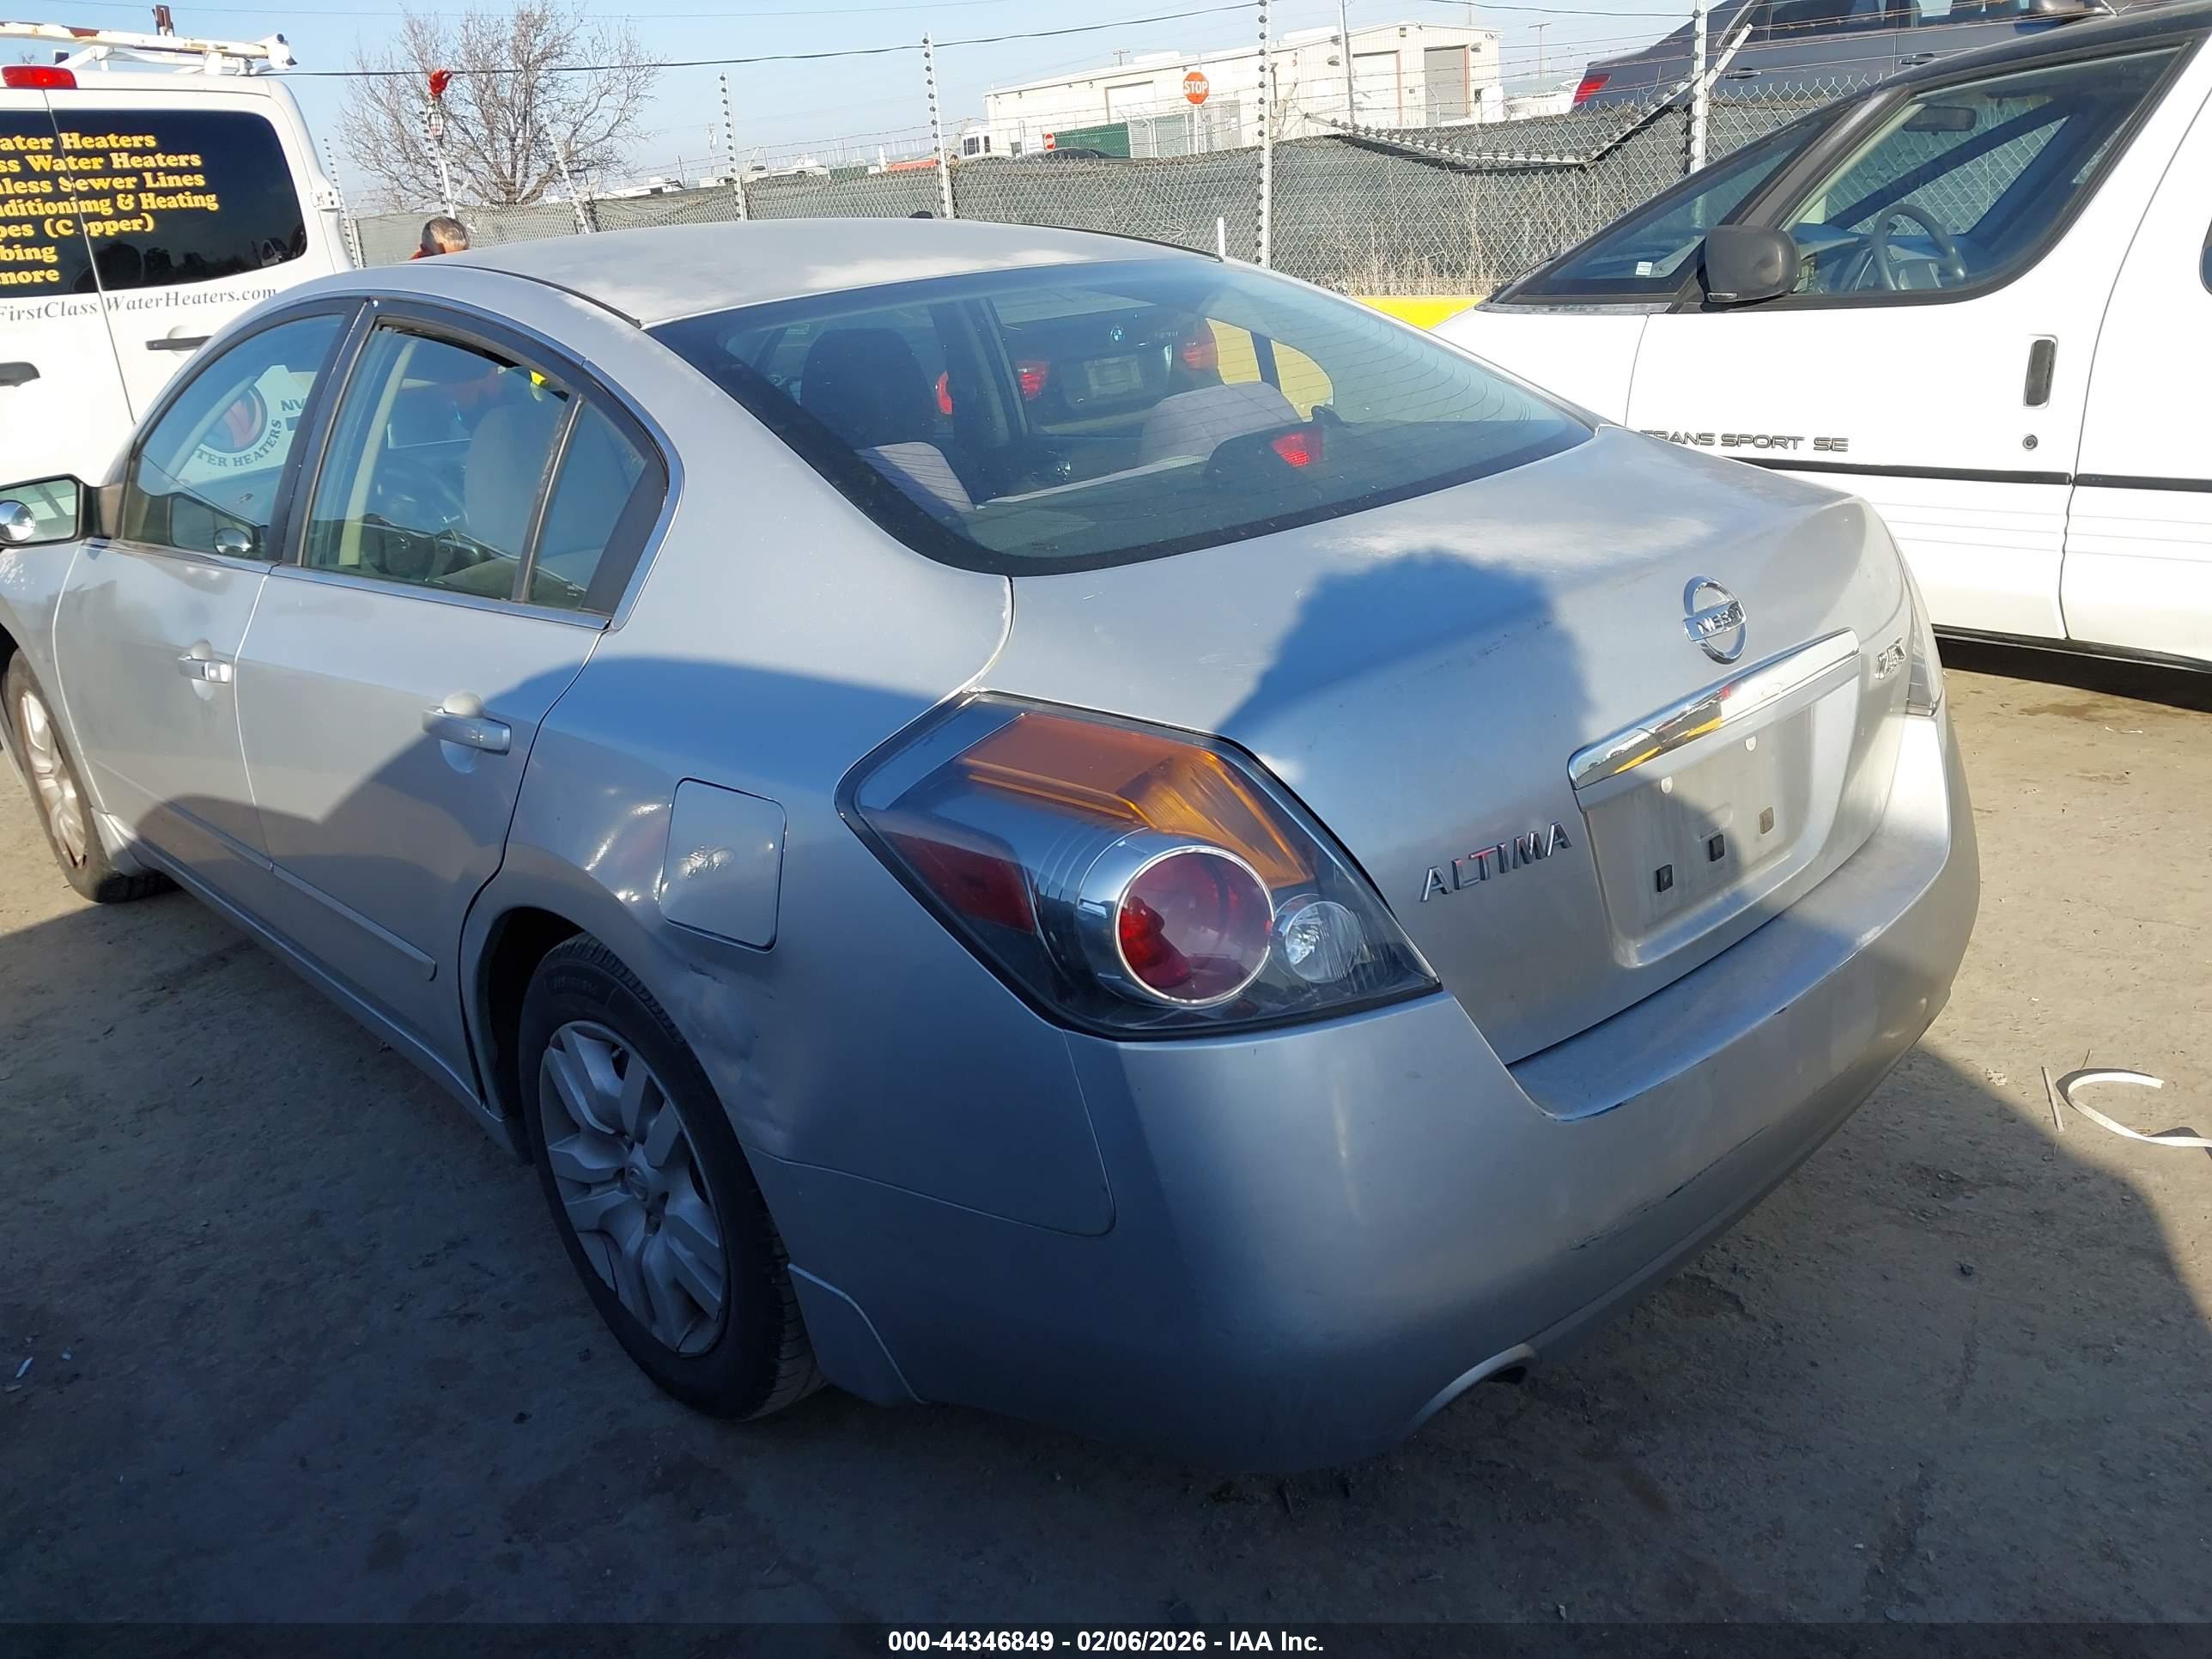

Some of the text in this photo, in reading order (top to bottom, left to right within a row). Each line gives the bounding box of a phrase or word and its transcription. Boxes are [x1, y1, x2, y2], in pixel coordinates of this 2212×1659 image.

[1184, 81, 1208, 94] STOP
[59, 132, 156, 149] Heaters
[25, 155, 104, 172] Water
[110, 152, 202, 169] Heaters
[58, 176, 137, 191] Sewer
[142, 172, 206, 188] Lines
[116, 193, 135, 211] &
[138, 191, 220, 211] Heating
[232, 419, 282, 467] HEATERS
[1721, 433, 1805, 450] SPORT
[1814, 436, 1849, 452] SE
[1696, 604, 1742, 635] NISSAN
[1420, 821, 1572, 902] ALTIMA
